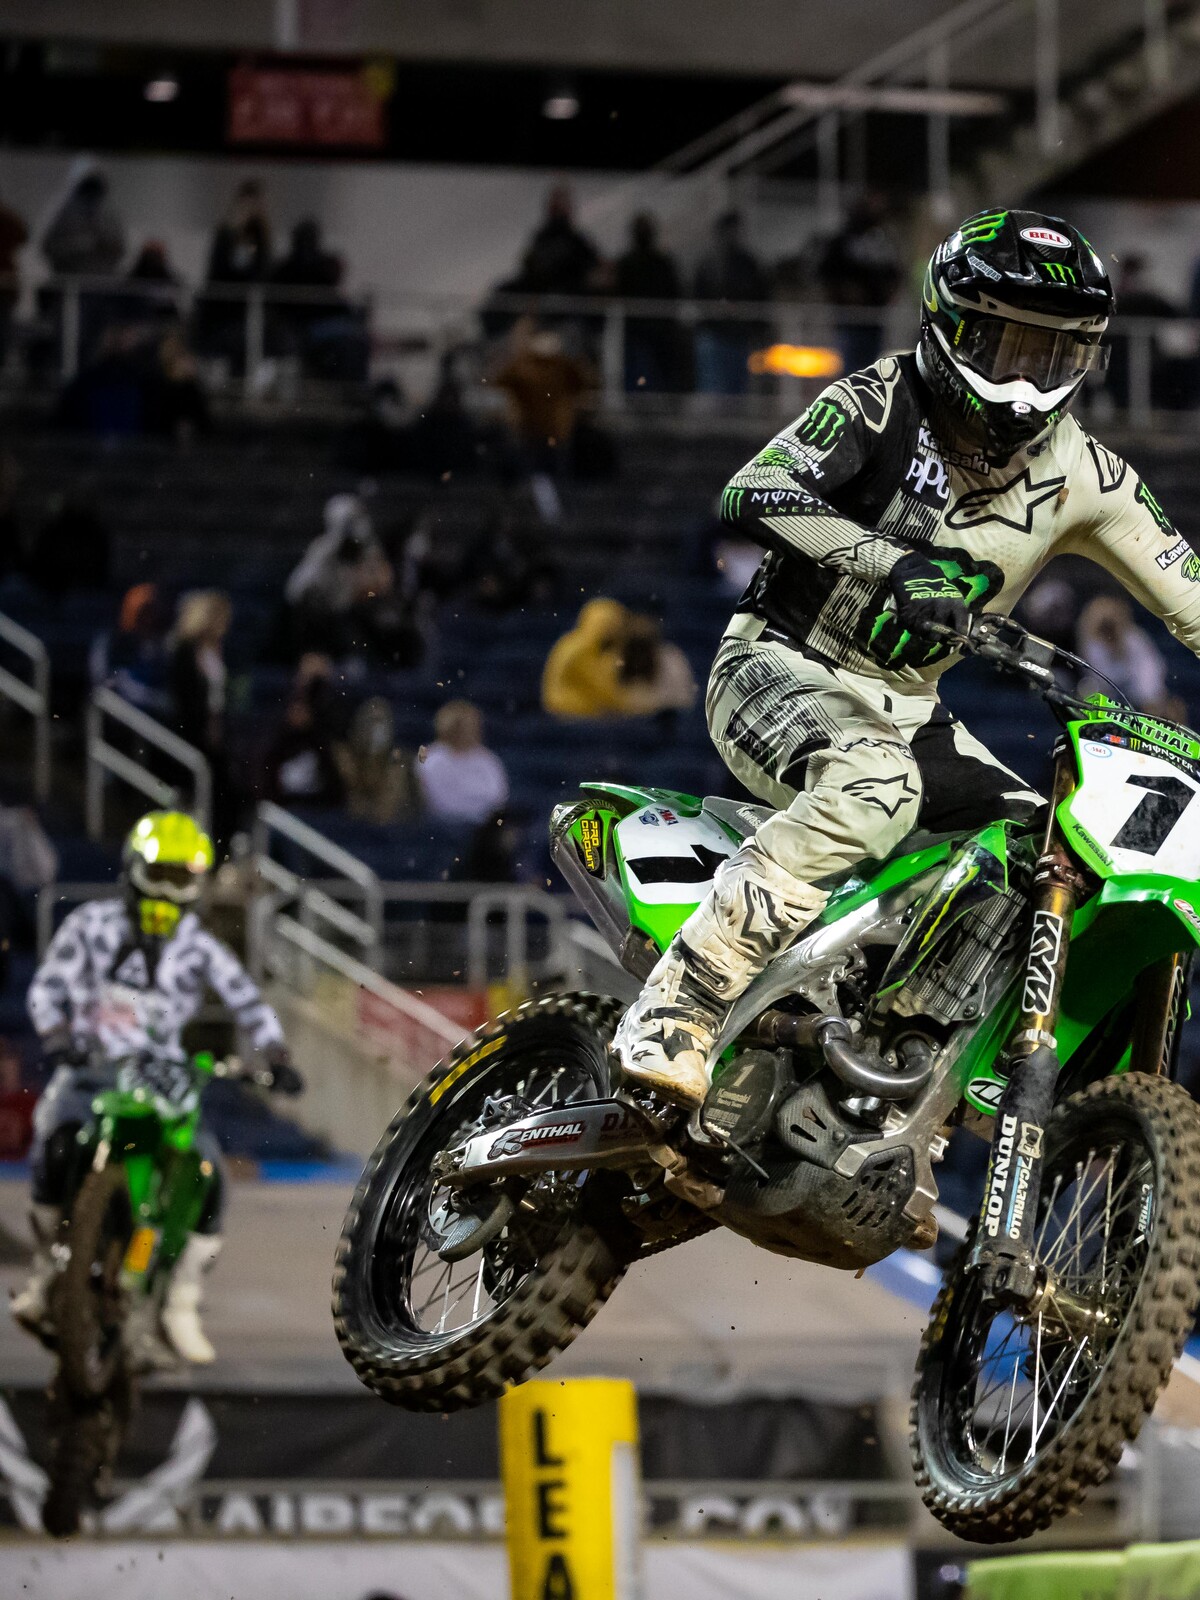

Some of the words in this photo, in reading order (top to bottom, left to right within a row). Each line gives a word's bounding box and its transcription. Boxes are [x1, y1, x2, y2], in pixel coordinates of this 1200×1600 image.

[1028, 230, 1064, 244] BELL
[953, 319, 966, 346] OAKLEY
[910, 590, 963, 600] ASTARS
[590, 820, 600, 847] PRO
[1108, 774, 1197, 857] 1
[581, 819, 595, 870] CIRCUIT
[1071, 822, 1113, 868] Kawasaki
[985, 1113, 1018, 1237] DUNLOP
